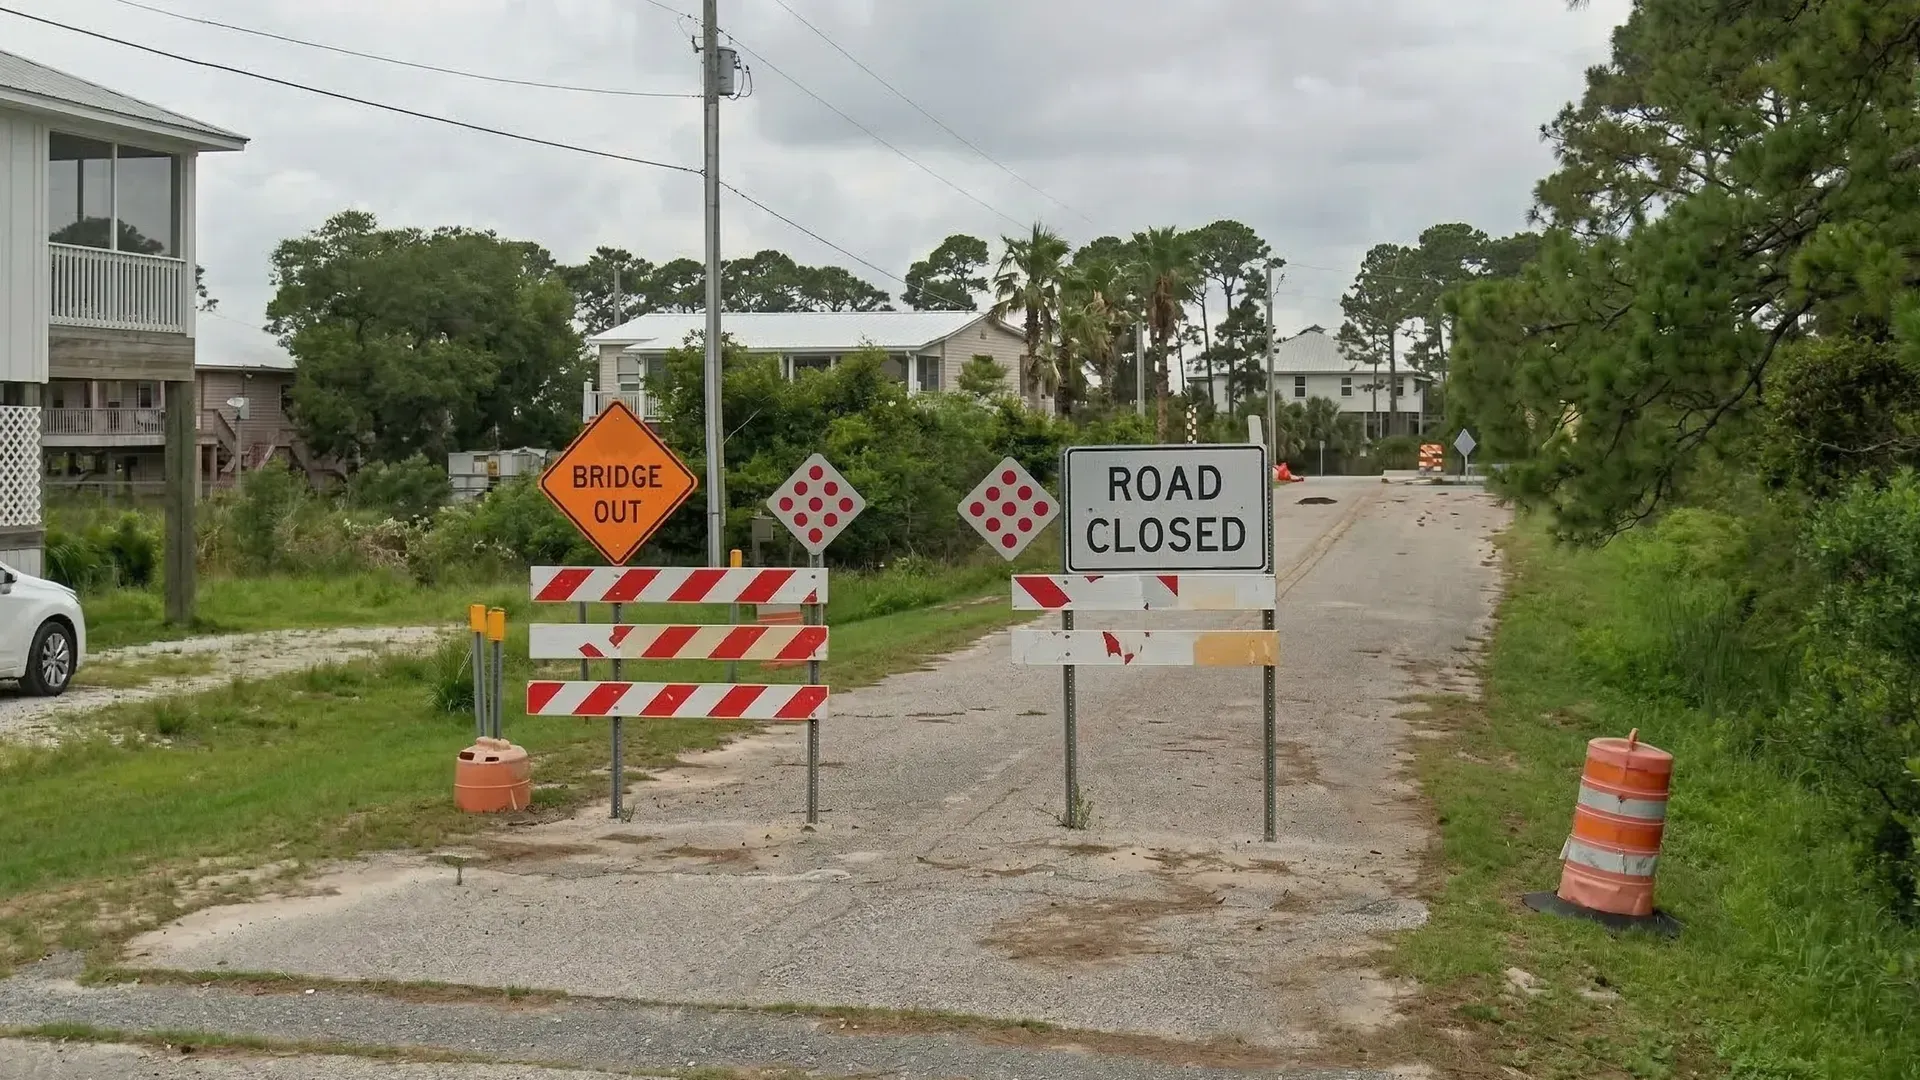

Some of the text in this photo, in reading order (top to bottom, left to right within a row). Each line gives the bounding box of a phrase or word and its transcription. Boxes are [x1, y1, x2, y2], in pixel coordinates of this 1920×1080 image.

[573, 464, 663, 489] BRIDGE
[1109, 465, 1222, 502] ROAD
[594, 500, 642, 524] OUT
[1086, 516, 1246, 553] CLOSED
